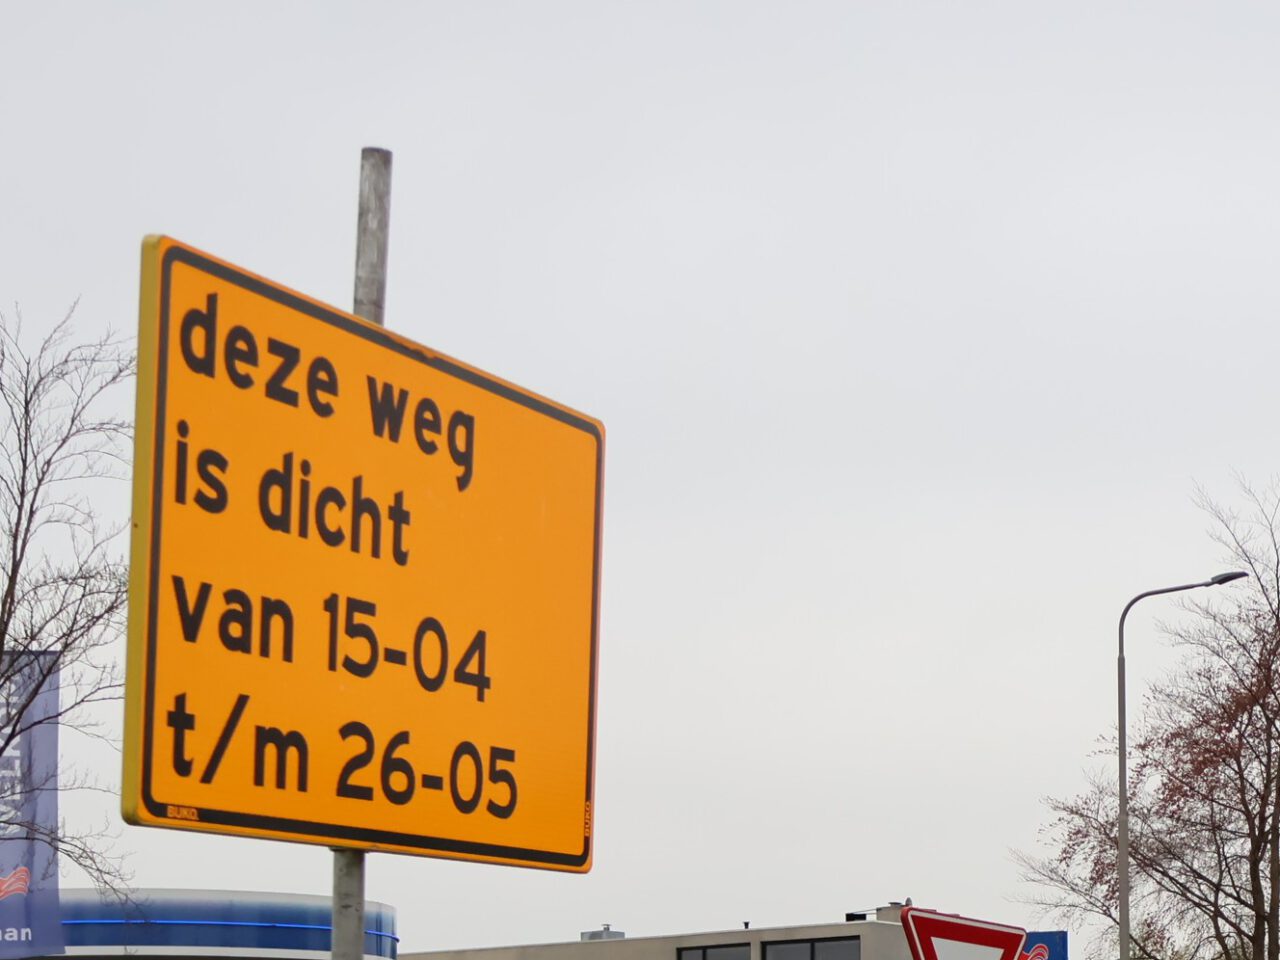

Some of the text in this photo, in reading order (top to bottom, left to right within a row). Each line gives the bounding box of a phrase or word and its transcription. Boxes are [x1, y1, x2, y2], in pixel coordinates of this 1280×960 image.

[179, 293, 475, 491] deze weg
[175, 420, 411, 566] is dicht
[172, 575, 491, 702] van 15-04
[166, 692, 518, 819] t/m 26-05
